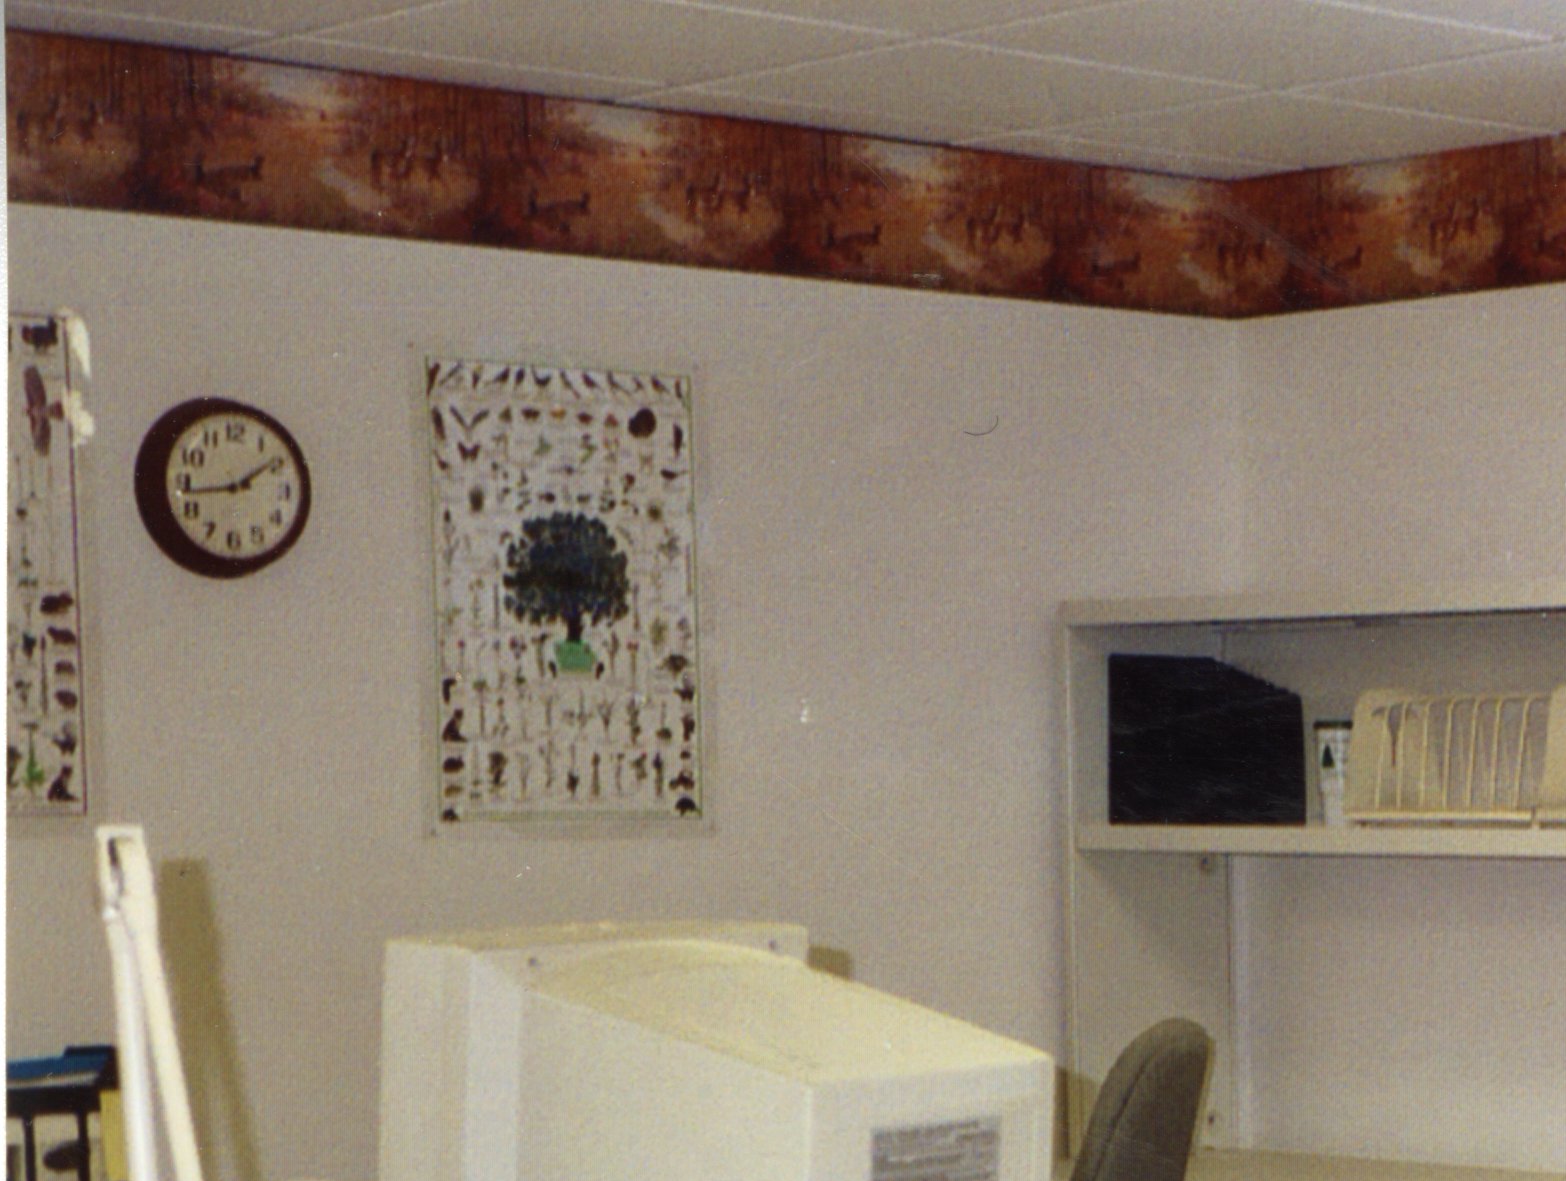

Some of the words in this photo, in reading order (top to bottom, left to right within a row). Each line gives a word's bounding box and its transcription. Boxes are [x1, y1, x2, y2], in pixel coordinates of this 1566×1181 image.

[203, 430, 218, 448] 11
[226, 422, 246, 443] 12
[257, 435, 264, 453] 1
[182, 448, 205, 468] 10
[270, 455, 284, 474] 2
[176, 473, 191, 493] 9
[278, 483, 291, 500] 3
[184, 501, 199, 519] 8
[269, 509, 282, 526] 4
[203, 521, 216, 539] 7
[249, 525, 265, 544] 5
[226, 531, 242, 550] 6
